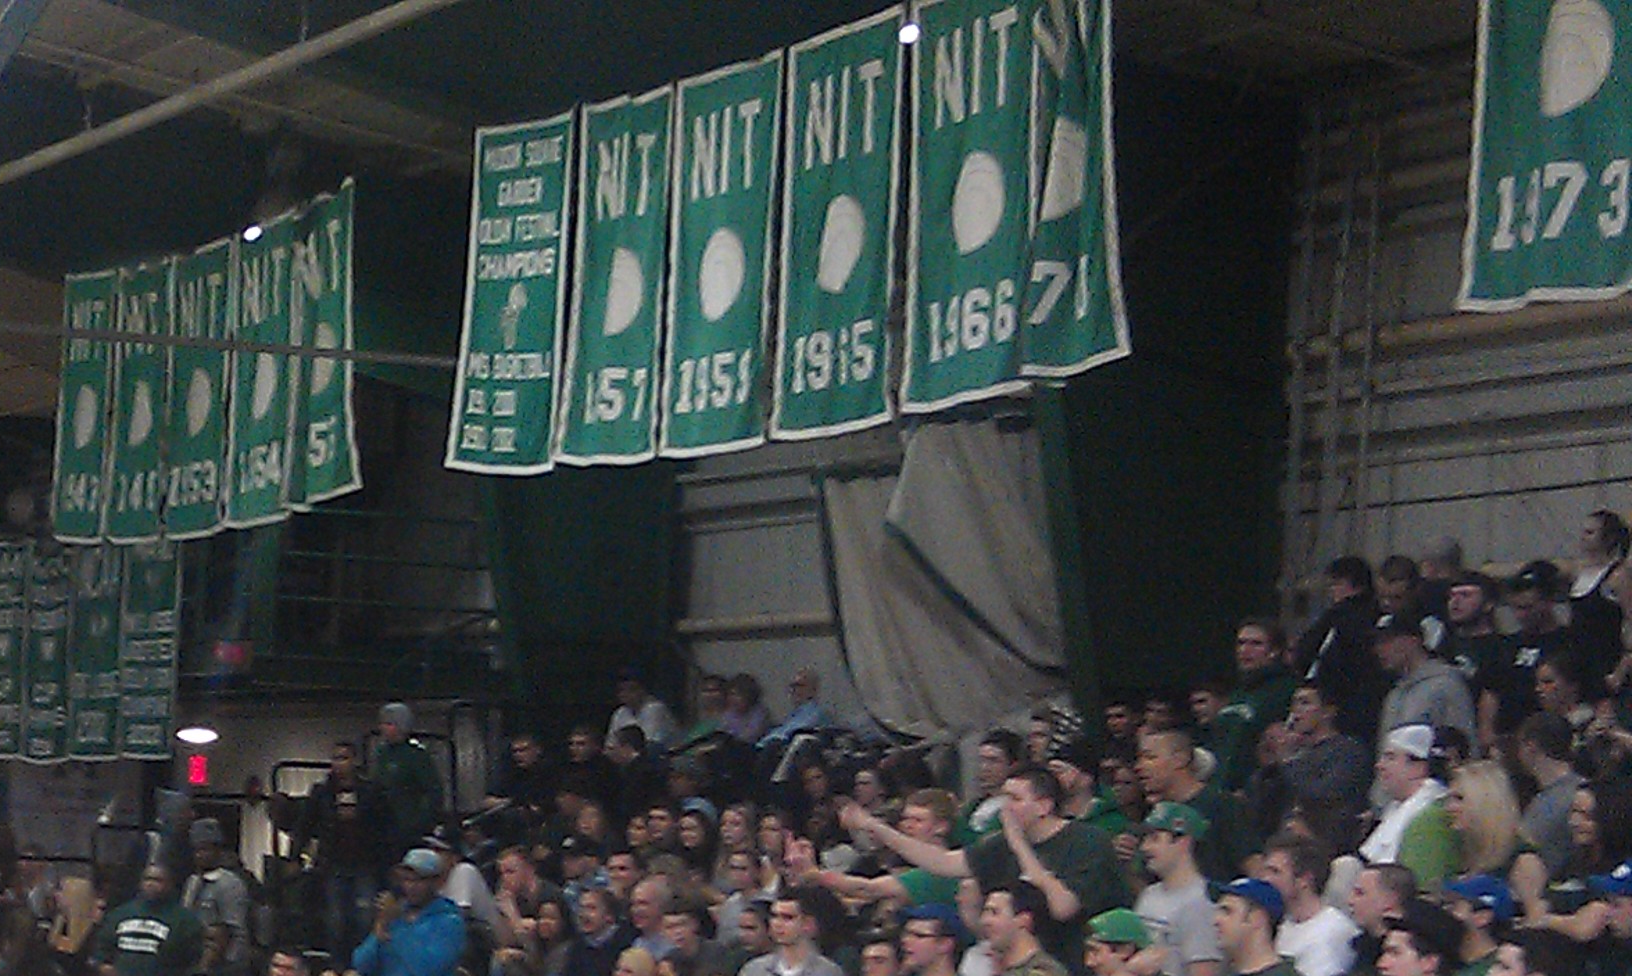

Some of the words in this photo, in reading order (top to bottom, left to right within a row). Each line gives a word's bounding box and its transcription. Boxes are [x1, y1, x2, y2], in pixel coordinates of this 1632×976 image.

[804, 59, 884, 171] NIT
[934, 4, 1018, 130] NIT
[596, 131, 656, 222] NIT
[690, 99, 762, 201] NIT
